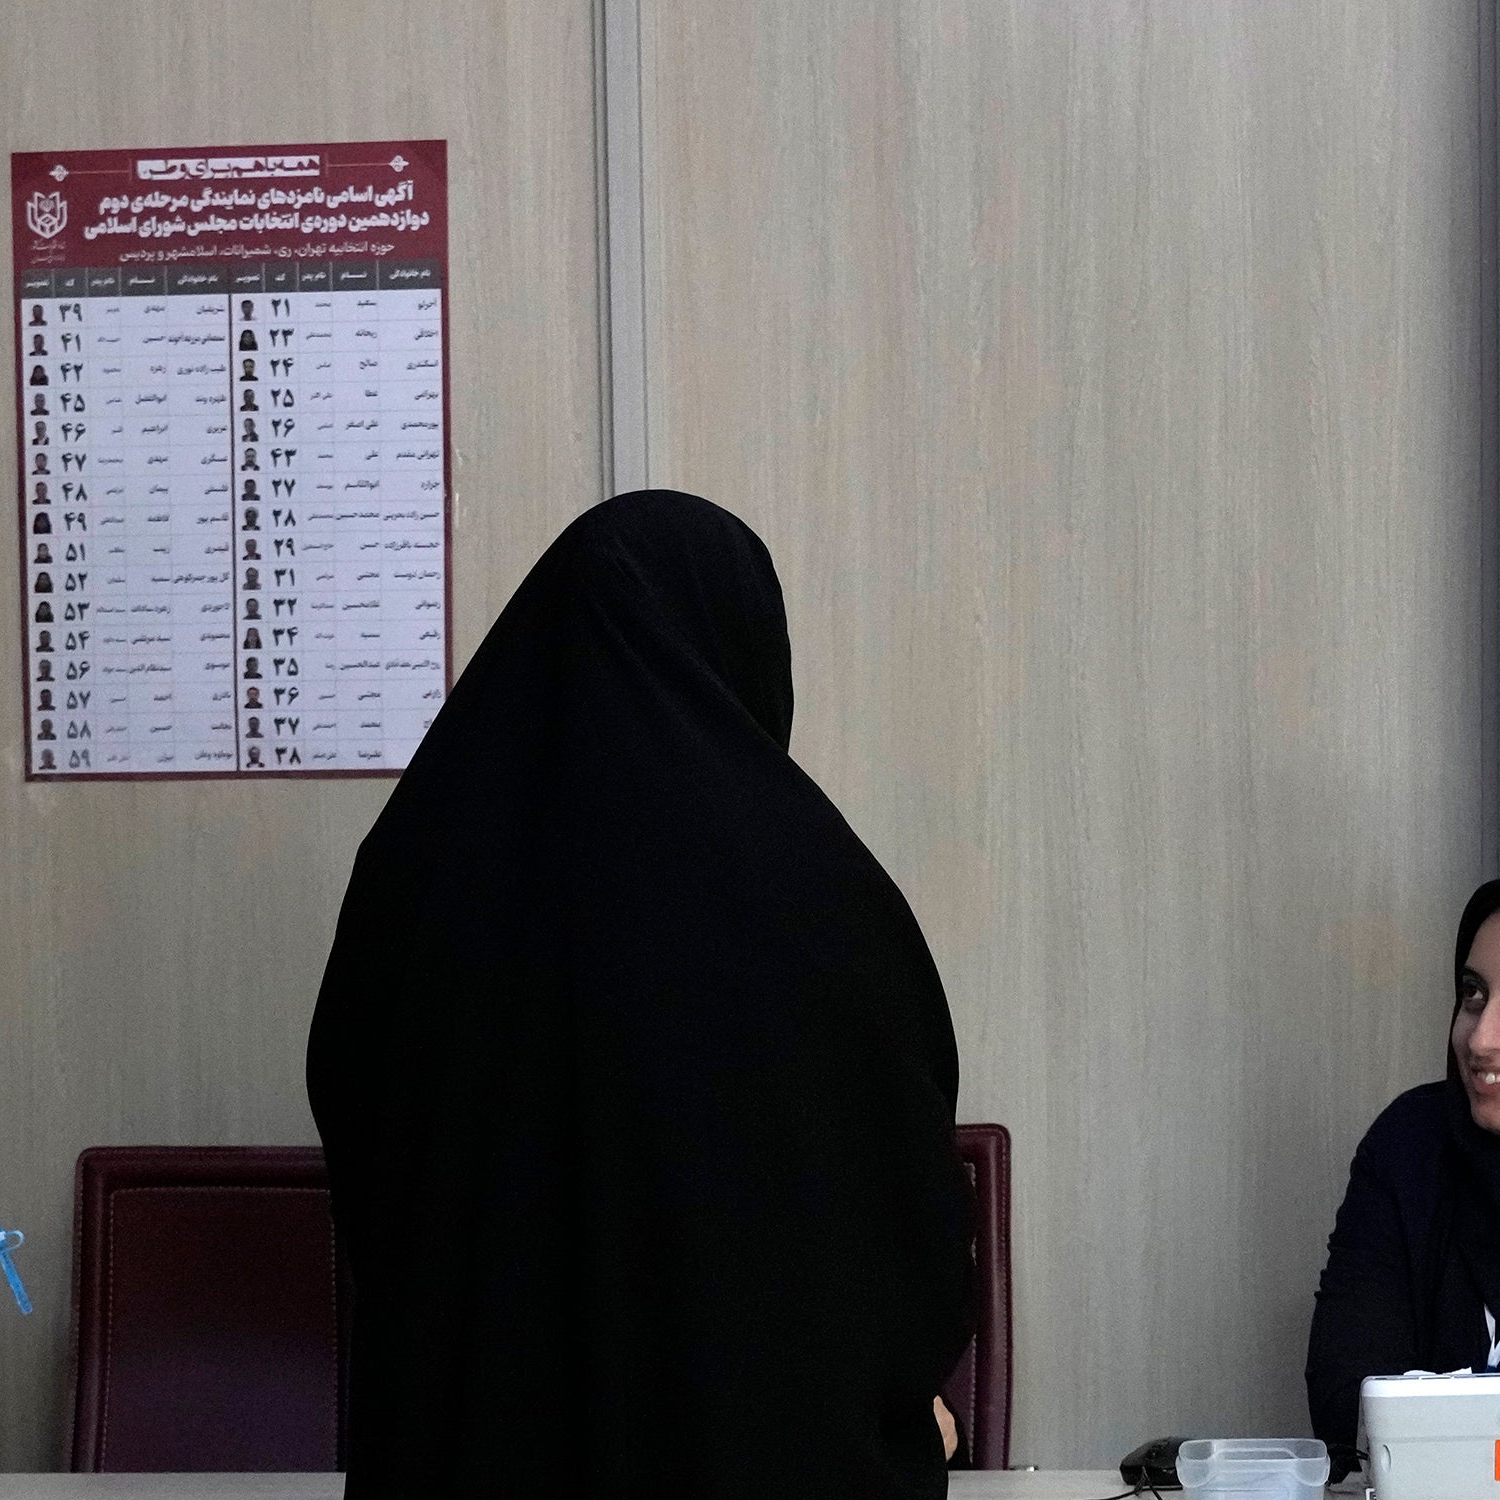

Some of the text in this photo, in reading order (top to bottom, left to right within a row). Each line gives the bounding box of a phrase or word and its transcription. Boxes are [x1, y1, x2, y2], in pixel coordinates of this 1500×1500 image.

[190, 187, 256, 213] نمایندگی
[257, 186, 325, 210] نامزدهای
[326, 185, 373, 208] اسامی
[374, 179, 414, 207] آگهی
[99, 195, 130, 215] دوم
[83, 216, 137, 240] اسلامی
[138, 214, 186, 238] شورای
[187, 214, 238, 237] مجلس
[239, 211, 300, 234] انتخابات
[348, 209, 430, 232] دوازدهمین
[164, 245, 218, 261] اسلامشهر
[328, 241, 368, 256] انتخابیه
[370, 242, 395, 256] حوزه
[58, 303, 83, 322] ۳۹
[271, 299, 290, 316] ۲۱
[60, 332, 81, 351] ۴۱
[269, 329, 294, 346] ۲۳
[60, 362, 83, 381] ۴۲
[270, 357, 294, 376] ۲۴
[60, 392, 85, 413] ۴۵
[270, 389, 294, 408] ۲۵
[61, 422, 86, 441] ۴۶
[271, 418, 295, 437] ۲۶
[61, 452, 87, 471] ۴۷
[61, 482, 88, 501] ۴۸
[271, 479, 296, 496] ۲۷
[63, 512, 87, 531] ۴۹
[272, 509, 296, 526] ۲۸
[65, 543, 85, 562] ۵۱
[273, 537, 295, 556] ۲۹
[64, 573, 88, 592] ۵۲
[274, 569, 295, 586] ۳۱
[64, 602, 90, 621] ۵۳
[273, 598, 297, 616] ۳۲
[65, 630, 89, 651] ۵۴
[272, 626, 298, 646] ۳۴
[66, 660, 90, 681] ۵۶
[272, 657, 299, 677] ۳۵
[66, 691, 91, 710] ۵۷
[273, 686, 299, 705] ۳۶
[66, 720, 92, 739] ۵۸
[273, 717, 300, 735] ۳۷
[68, 749, 91, 769] ۵۹
[274, 747, 302, 764] ۳۸
